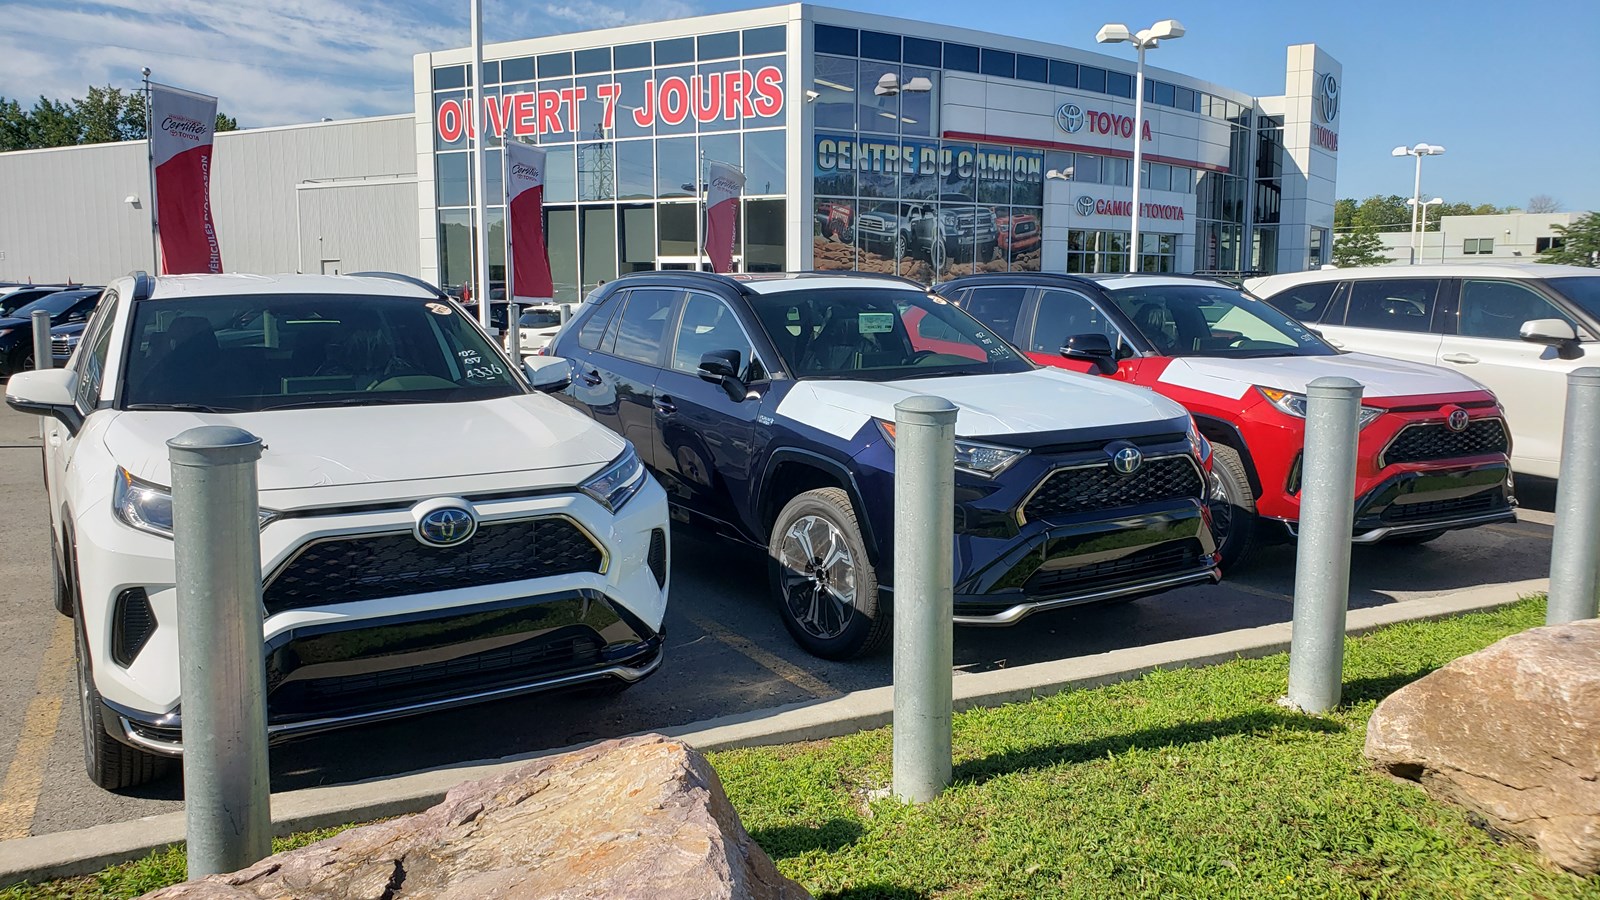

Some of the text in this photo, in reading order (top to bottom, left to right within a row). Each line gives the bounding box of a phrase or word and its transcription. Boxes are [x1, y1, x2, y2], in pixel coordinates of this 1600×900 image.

[437, 65, 784, 143] OUVERT 7 JOURS
[179, 131, 200, 142] TOYOTA
[1087, 110, 1152, 141] TOYOA
[817, 139, 1041, 183] CENTRE DU CAMION
[1144, 203, 1185, 221] TOYOTA
